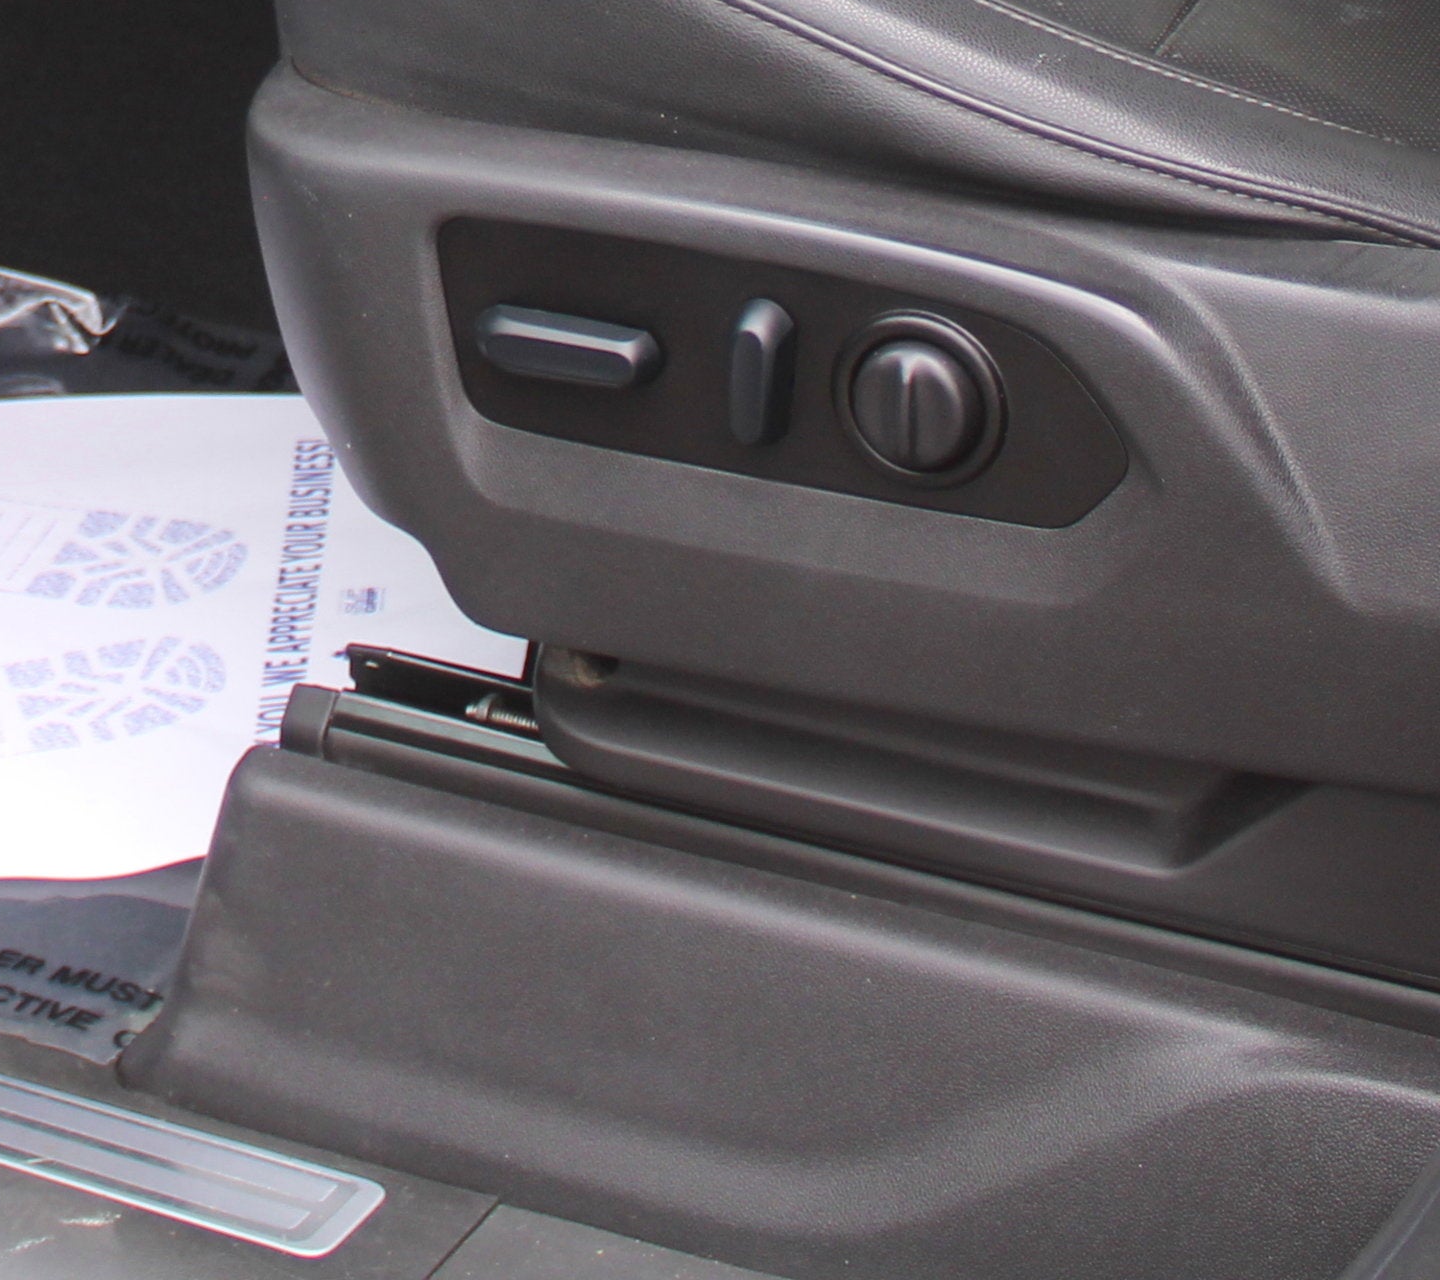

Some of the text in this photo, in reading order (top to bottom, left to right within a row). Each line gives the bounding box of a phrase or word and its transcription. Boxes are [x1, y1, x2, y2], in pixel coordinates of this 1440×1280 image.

[281, 521, 328, 567] YOUR
[266, 562, 323, 657] APPRECIATE
[261, 656, 309, 688] WE
[48, 964, 164, 1012] MUST
